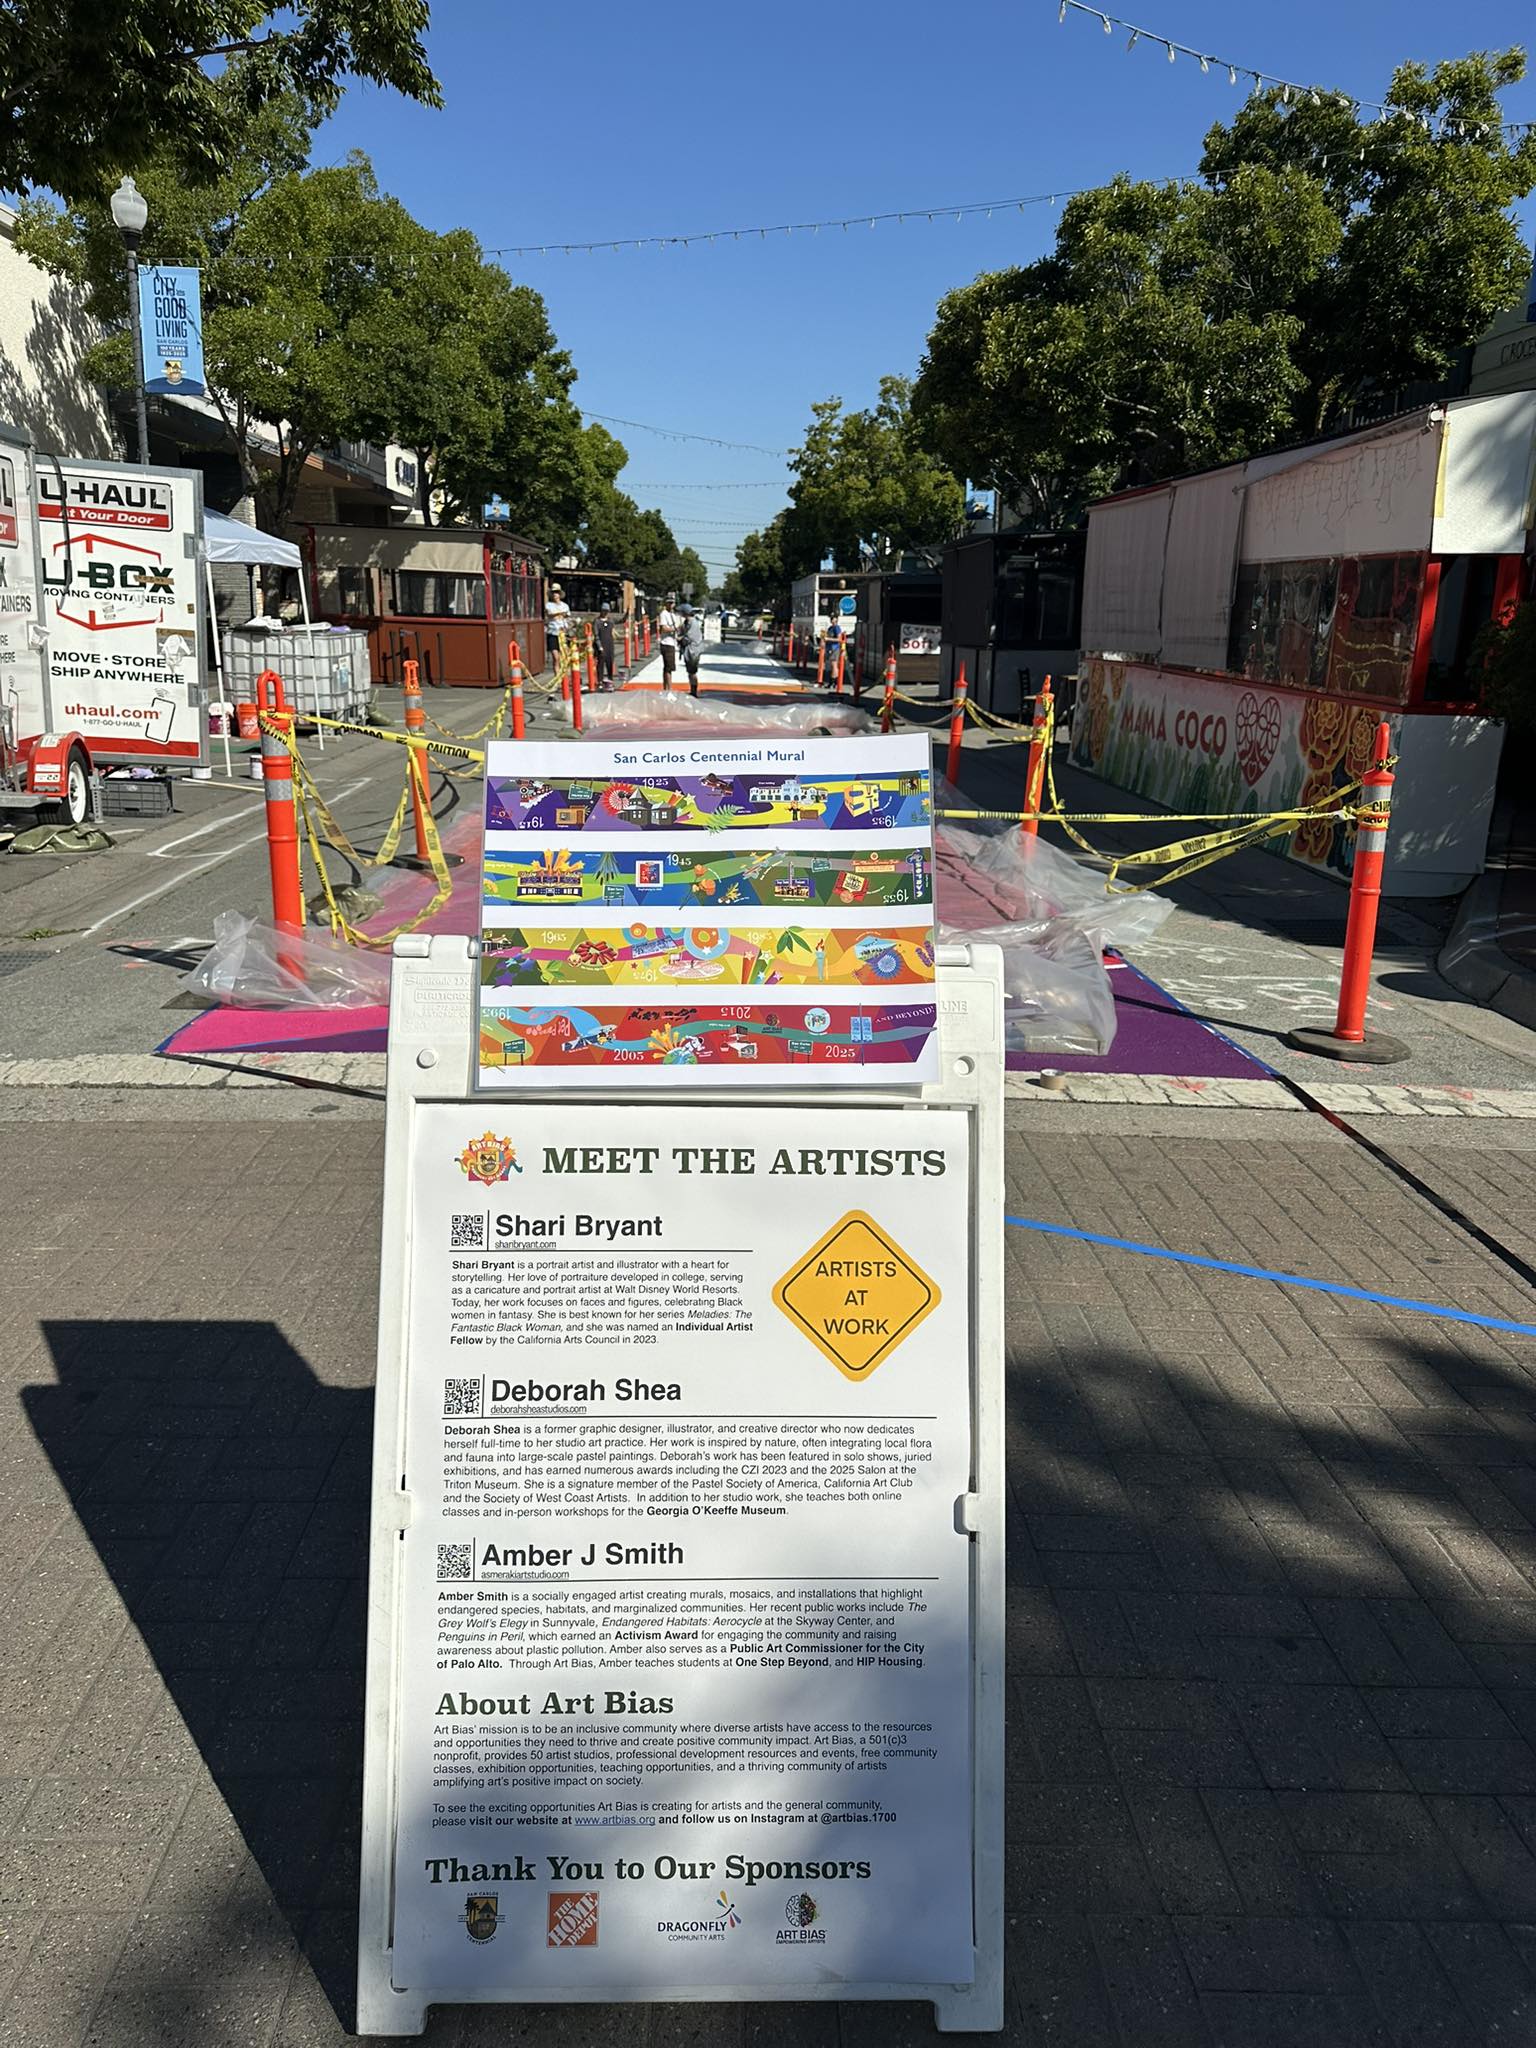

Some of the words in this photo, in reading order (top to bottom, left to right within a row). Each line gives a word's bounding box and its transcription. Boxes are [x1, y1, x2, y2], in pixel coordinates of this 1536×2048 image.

[153, 276, 177, 296] CITY
[154, 296, 187, 320] GOOD
[155, 319, 188, 338] LIVING
[40, 478, 167, 510] U-HAUL
[80, 509, 113, 522] Your
[117, 512, 154, 525] Door
[42, 558, 175, 594] U-BOX
[53, 651, 101, 664] MOVE
[112, 655, 167, 668] STORE
[51, 666, 91, 678] SHIP
[93, 669, 185, 684] ANYWHERE
[65, 703, 160, 720] uhaul.com
[1175, 709, 1228, 756] COCO
[426, 742, 470, 759] CAUTION
[613, 752, 638, 764] San
[642, 752, 686, 763] Carlos
[690, 750, 762, 763] Centennial
[767, 750, 805, 761] Mural
[642, 778, 669, 790] 1925
[666, 854, 692, 866] 1945
[882, 889, 909, 903] 1955
[541, 931, 567, 944] 1965
[721, 1007, 751, 1019] 2015
[895, 1006, 935, 1021] BEYOND!
[613, 1048, 645, 1062] 2005
[825, 1045, 856, 1058] 2025
[542, 1147, 660, 1174] MEET
[672, 1148, 755, 1174] THE
[769, 1149, 947, 1176] ARTISTS
[495, 1214, 565, 1237] Shari
[575, 1214, 663, 1241] Bryant
[495, 1240, 557, 1249] sharibryant.com
[452, 1259, 478, 1269] Shari
[481, 1259, 515, 1272] Bryant
[517, 1259, 525, 1269] is
[527, 1261, 534, 1269] a
[536, 1259, 569, 1272] portrait
[571, 1259, 594, 1269] artist
[596, 1259, 614, 1269] and
[616, 1259, 659, 1269] illustrator
[661, 1259, 680, 1269] with
[682, 1261, 688, 1269] a
[690, 1259, 714, 1269] heart
[717, 1259, 729, 1269] for
[815, 1261, 897, 1277] ARTISTS
[844, 1290, 869, 1306] AT
[823, 1318, 889, 1335] WORK
[450, 1334, 483, 1345] Fellow
[485, 1334, 497, 1347] by
[499, 1334, 514, 1345] the
[517, 1334, 561, 1345] California
[563, 1334, 582, 1344] Arts
[584, 1334, 620, 1344] Council
[622, 1334, 630, 1344] in
[633, 1334, 656, 1344] 2023.
[491, 1379, 605, 1402] Deborah
[614, 1378, 682, 1401] Shea
[490, 1404, 587, 1414] deborahsheastudios.com
[444, 1424, 490, 1434] Deborah
[493, 1424, 520, 1434] Shea
[523, 1423, 532, 1434] is
[534, 1426, 541, 1434] a
[544, 1423, 577, 1434] former
[579, 1423, 616, 1436] graphic
[618, 1423, 664, 1436] designer,
[667, 1423, 714, 1436] illustrator,
[717, 1423, 736, 1433] and
[738, 1423, 778, 1434] creative
[780, 1423, 818, 1434] director
[820, 1423, 841, 1434] who
[843, 1426, 864, 1434] now
[866, 1423, 914, 1434] dedicates
[481, 1543, 573, 1566] Amber
[581, 1544, 595, 1566] J
[605, 1542, 684, 1565] Smith
[481, 1570, 570, 1579] asmerakiartstudio.com
[437, 1590, 474, 1601] Amber
[476, 1590, 508, 1601] Smith
[511, 1590, 520, 1600] is
[522, 1592, 529, 1600] a
[532, 1590, 569, 1603] socially
[572, 1589, 616, 1602] engaged
[619, 1589, 643, 1600] artist
[646, 1589, 686, 1602] creating
[689, 1589, 726, 1602] murals,
[729, 1589, 773, 1602] mosaics,
[776, 1589, 795, 1599] and
[798, 1588, 857, 1599] installations
[859, 1588, 878, 1599] that
[881, 1588, 922, 1601] highlight
[435, 1691, 531, 1715] About
[541, 1691, 594, 1715] Art
[604, 1690, 674, 1714] Bias
[432, 1815, 466, 1828] please
[468, 1815, 492, 1826] visit
[495, 1817, 514, 1825] our
[516, 1815, 558, 1825] website
[561, 1815, 572, 1825] at
[574, 1814, 656, 1827] www.artbias.org
[658, 1814, 679, 1824] and
[681, 1814, 715, 1824] follow
[717, 1816, 731, 1824] us
[733, 1816, 747, 1824] on
[751, 1813, 804, 1826] Instagram
[807, 1813, 818, 1823] at
[820, 1812, 896, 1825] @artbias.1700
[425, 1856, 537, 1884] Thank
[546, 1856, 604, 1881] You
[615, 1857, 645, 1880] to
[654, 1855, 716, 1880] Our
[725, 1854, 872, 1886] Sponsors
[553, 1897, 574, 1920] THE
[547, 1892, 599, 1946] HOME
[657, 1921, 727, 1932] DRAGONFLY
[566, 1911, 599, 1947] DEPOT
[776, 1929, 798, 1940] ART
[800, 1929, 826, 1940] BIAS
